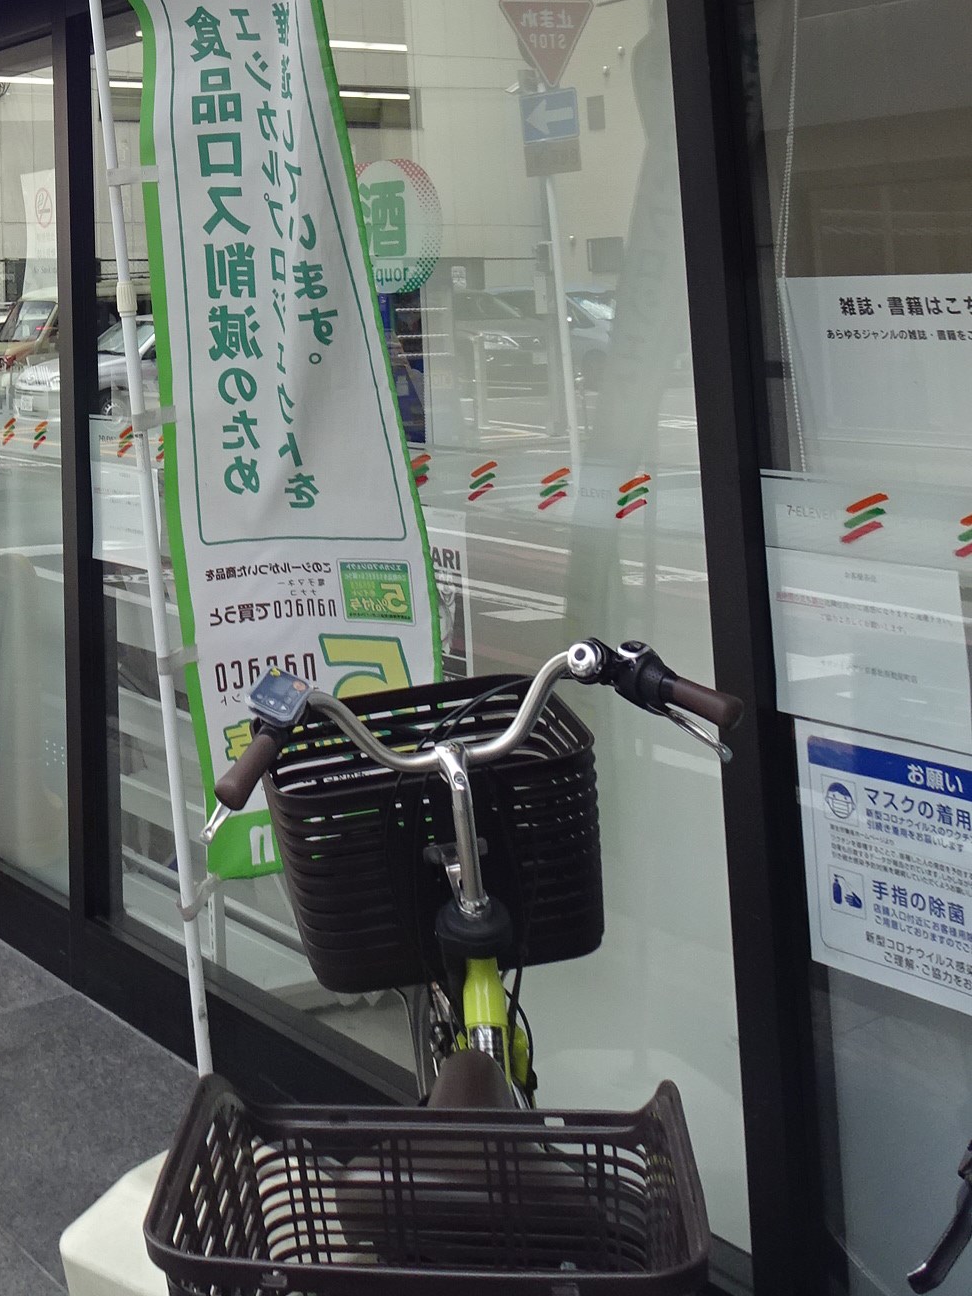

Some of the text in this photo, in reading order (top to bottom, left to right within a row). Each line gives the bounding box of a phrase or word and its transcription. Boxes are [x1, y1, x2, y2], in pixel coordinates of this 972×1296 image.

[359, 180, 407, 257] 酒
[906, 764, 964, 794] お願い
[864, 787, 972, 831] マスクの着用
[865, 807, 972, 844] 新型コロナウイルスのワクチ
[872, 879, 965, 926] 手指の除菌
[875, 914, 972, 954] ご用意しておりますのでご
